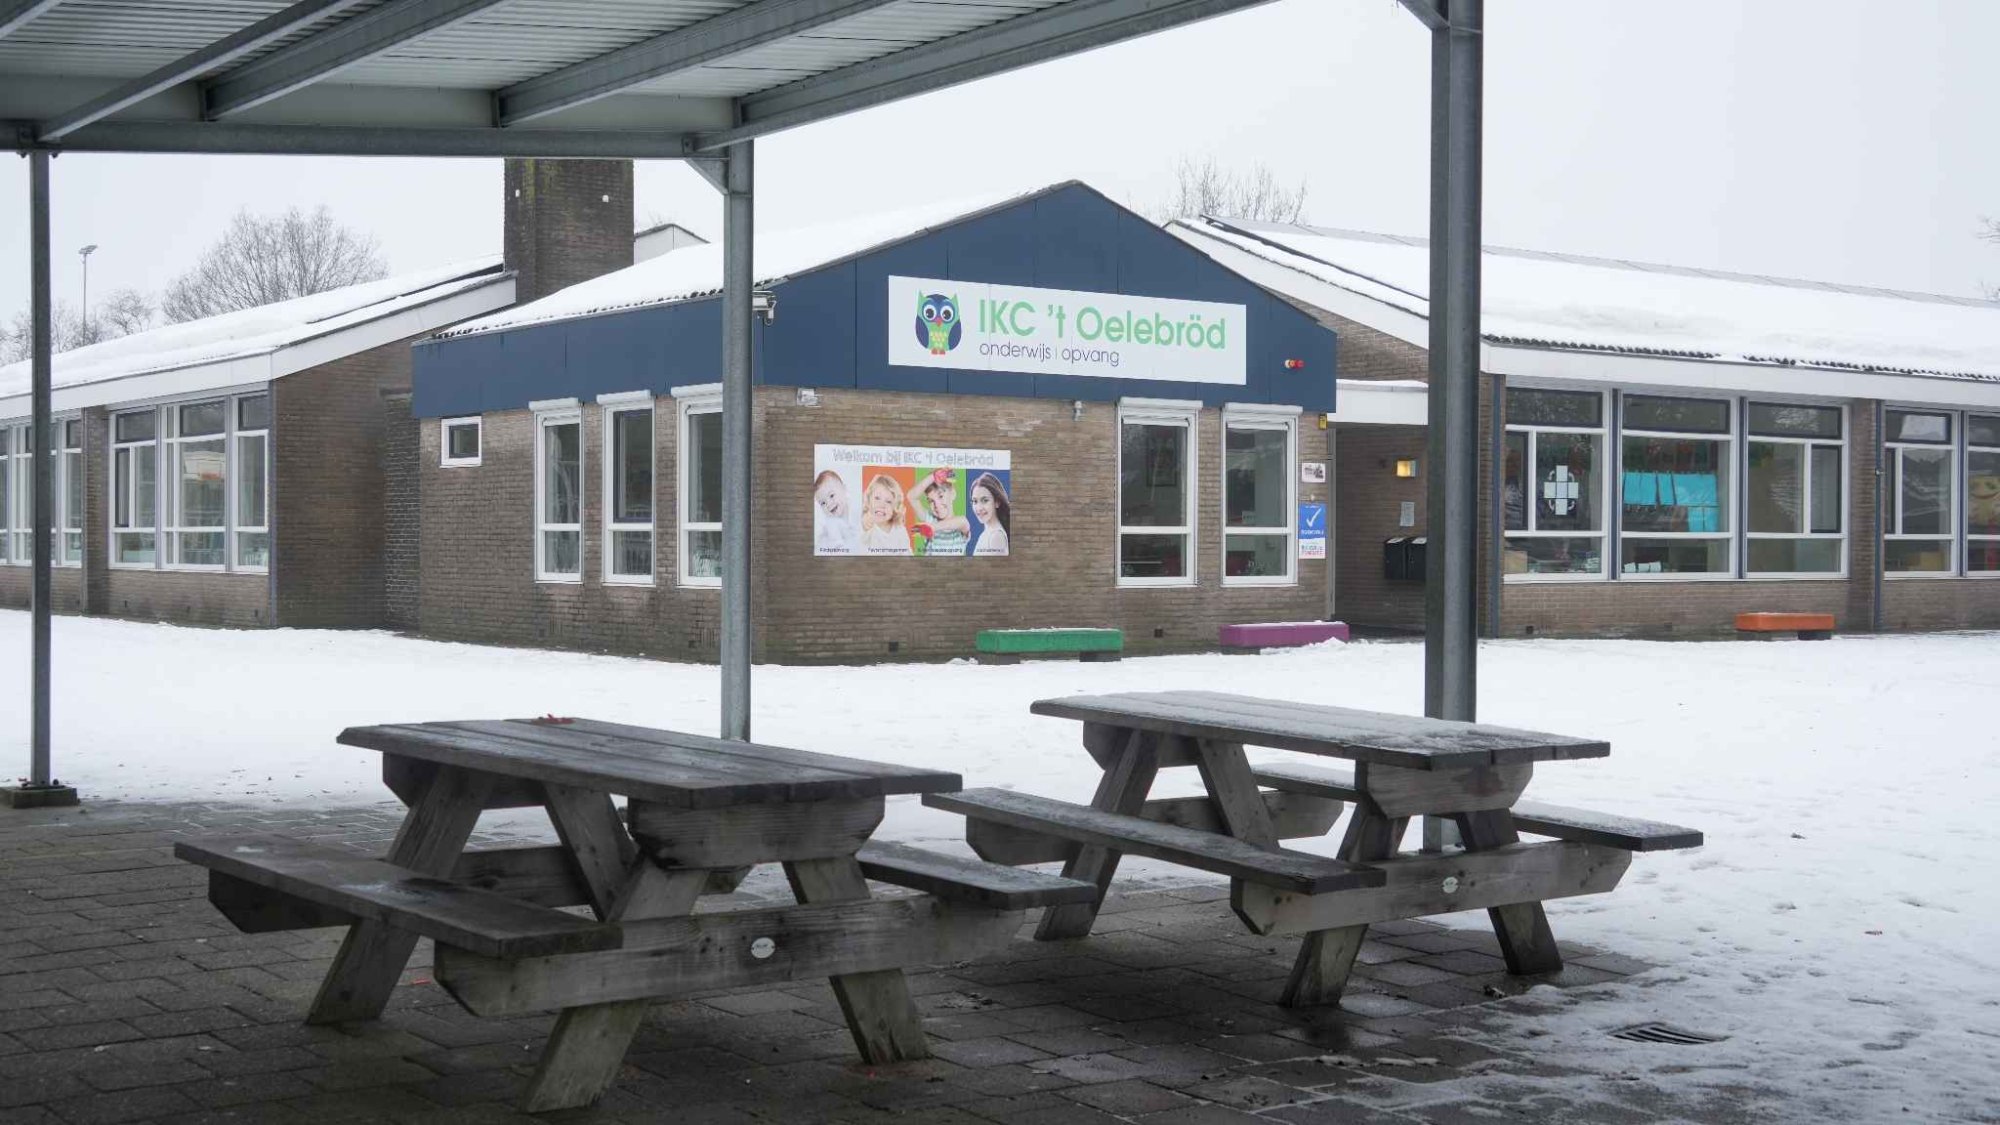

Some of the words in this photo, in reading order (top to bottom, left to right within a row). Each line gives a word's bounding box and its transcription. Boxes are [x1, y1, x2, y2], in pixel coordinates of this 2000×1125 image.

[978, 299, 1036, 337] IKC
[1076, 306, 1227, 350] Oelebröd
[979, 340, 1052, 364] onderwijs
[1061, 347, 1121, 367] opvang
[832, 447, 882, 463] Welkom
